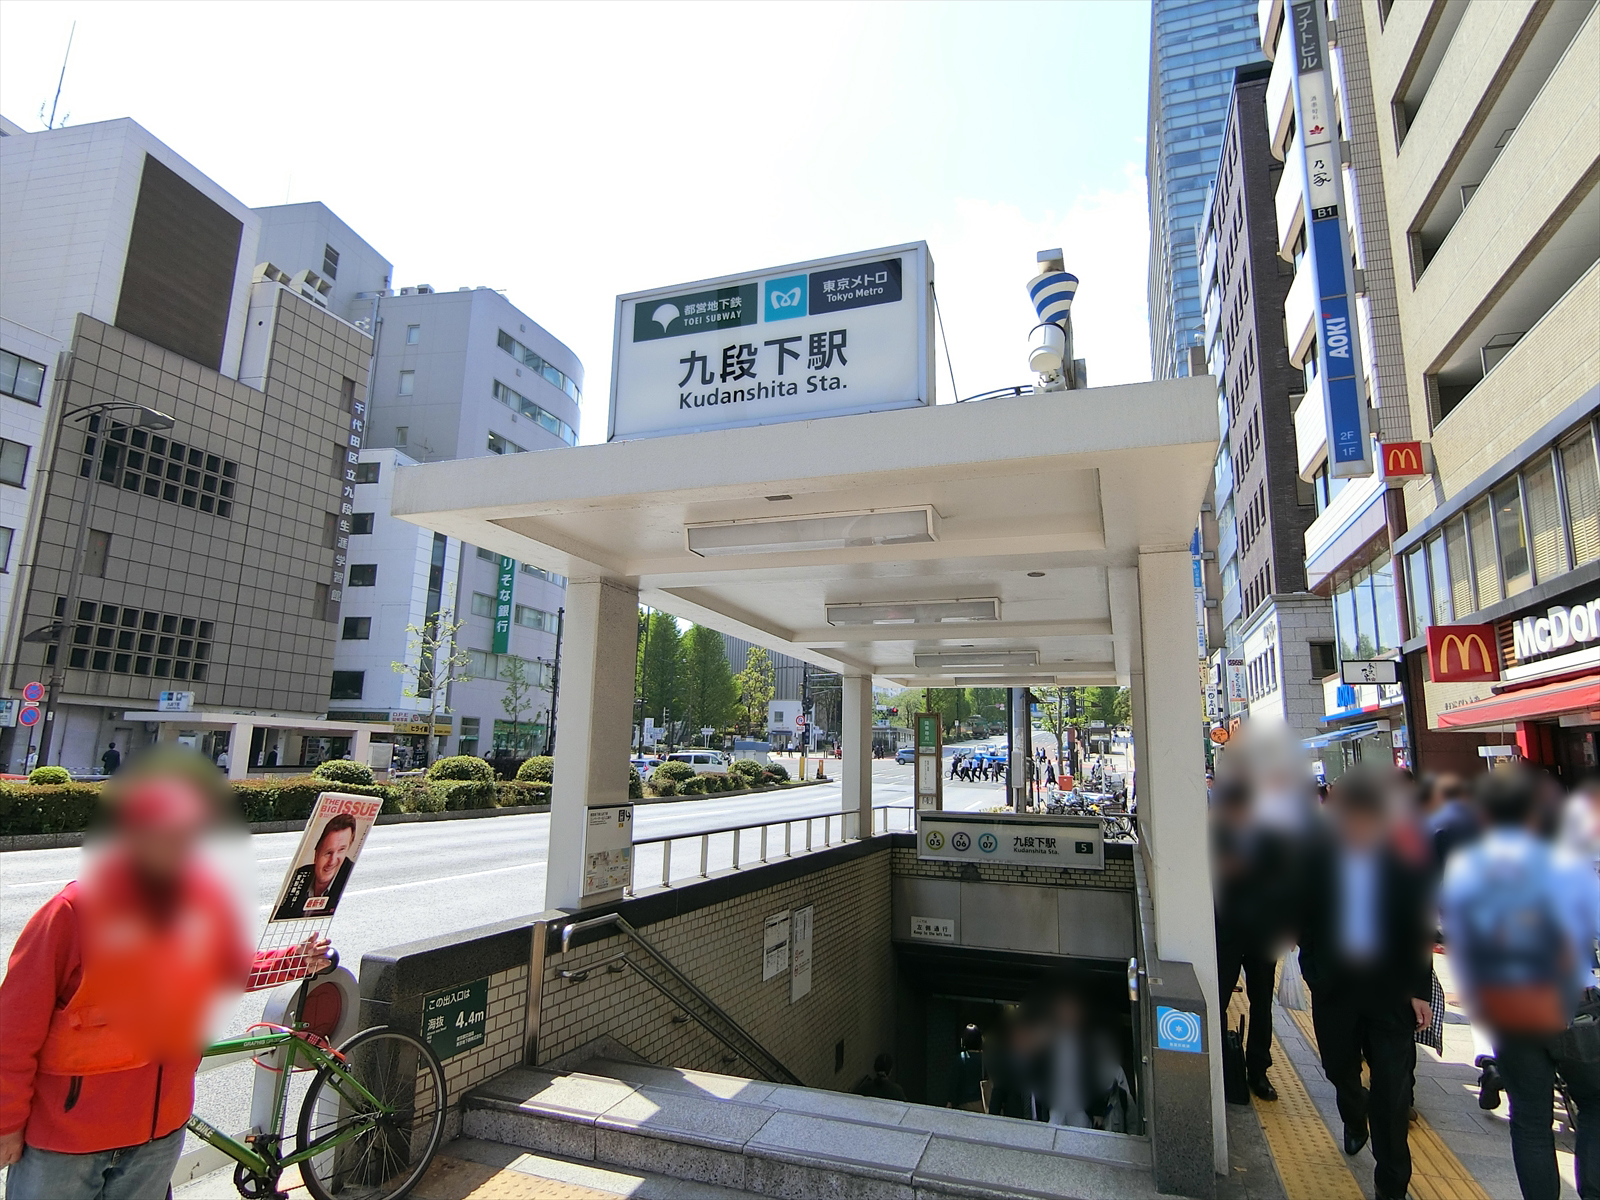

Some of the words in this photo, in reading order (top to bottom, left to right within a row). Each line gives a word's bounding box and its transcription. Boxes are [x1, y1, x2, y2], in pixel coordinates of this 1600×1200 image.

[1317, 207, 1333, 219] B1
[822, 271, 888, 294] 東京メトロ
[826, 290, 854, 304] Tokyo
[855, 286, 884, 298] Metro
[684, 296, 742, 317] 都営地下鉄
[684, 316, 703, 327] TOEI
[705, 310, 742, 323] SUBWAY
[1327, 316, 1350, 359] AOKI
[678, 328, 848, 388] 九段下駅
[680, 380, 799, 410] Kudanshita
[806, 375, 848, 394] Sta.
[1340, 431, 1355, 441] 2F
[1342, 447, 1356, 457] 1F
[331, 402, 365, 602] 千代田区立九段生涯学習館
[496, 558, 513, 633] りそな銀行
[320, 805, 337, 814] BIG
[325, 798, 341, 806] THE
[337, 800, 380, 817] ISSUE
[929, 839, 941, 847] 05
[956, 840, 967, 848] 06
[983, 841, 993, 849] 07
[1013, 836, 1056, 849] 九段下駅
[1081, 844, 1087, 852] 5
[429, 988, 470, 1010] この出入口は
[427, 1015, 445, 1031] 海抜
[455, 1011, 484, 1029] 4.4m
